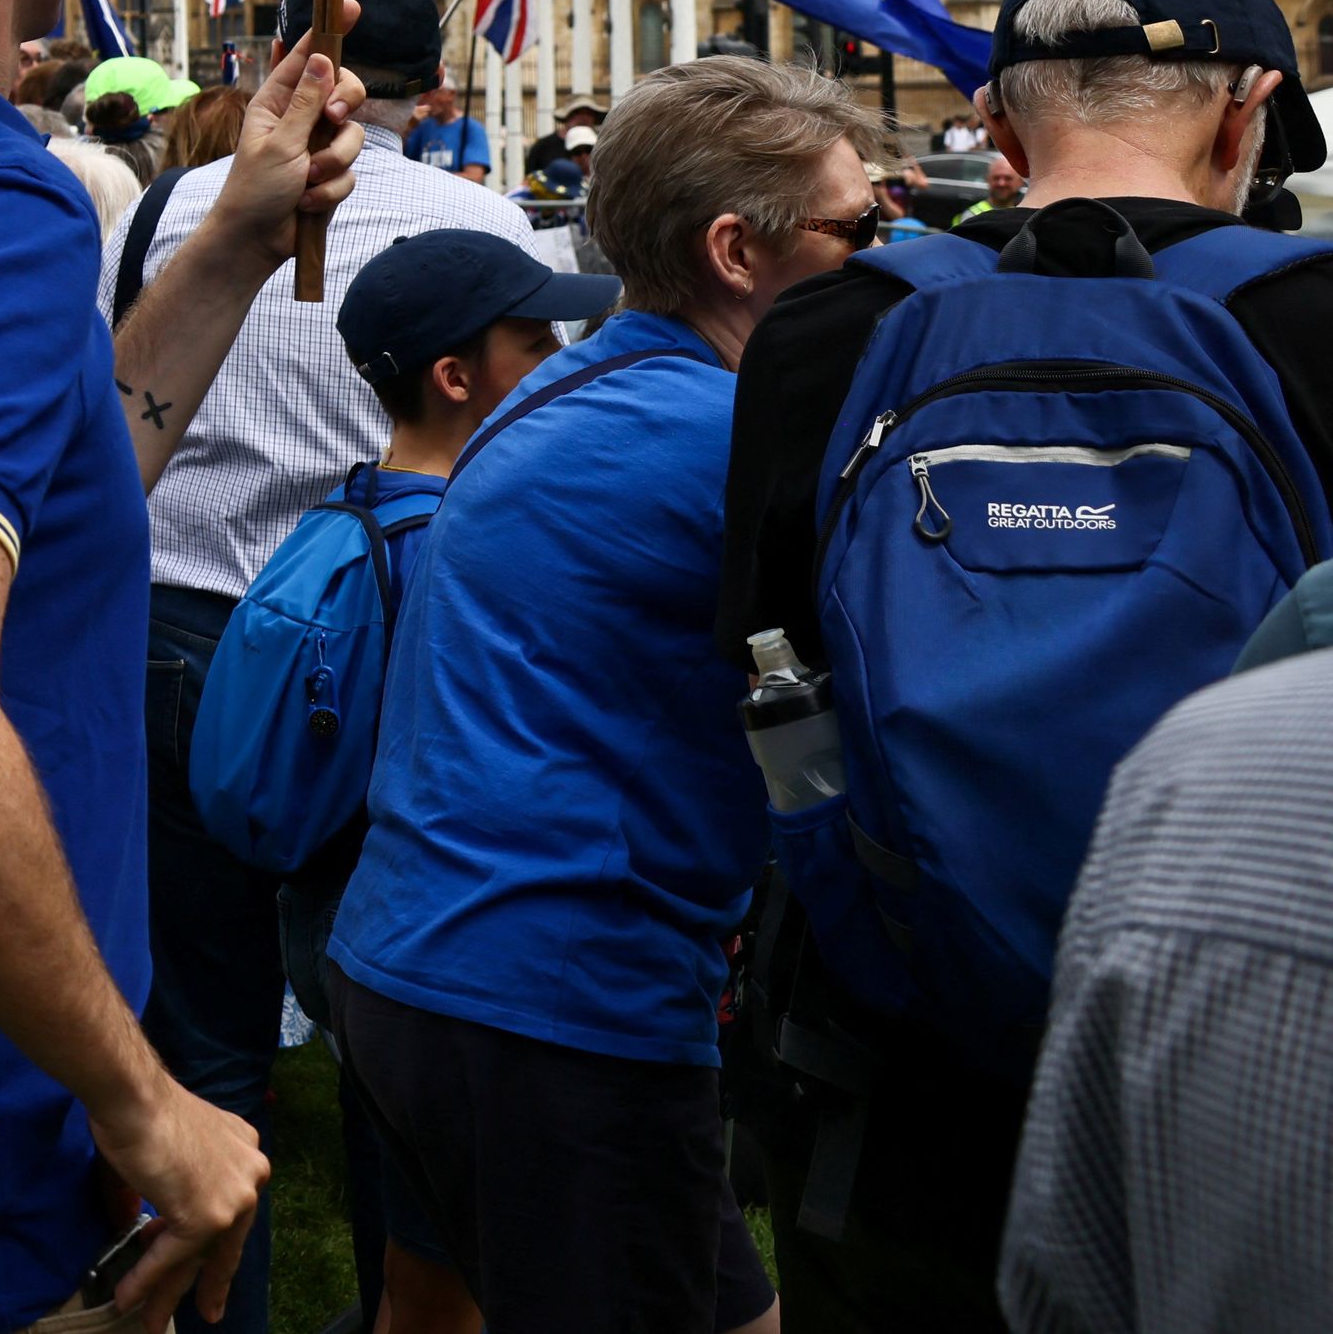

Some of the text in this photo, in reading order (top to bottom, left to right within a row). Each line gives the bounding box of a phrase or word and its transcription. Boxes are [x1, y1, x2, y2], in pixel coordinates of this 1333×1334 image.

[987, 502, 1073, 519] REGATTA
[987, 517, 1117, 530] GREAT OUTDOORS
